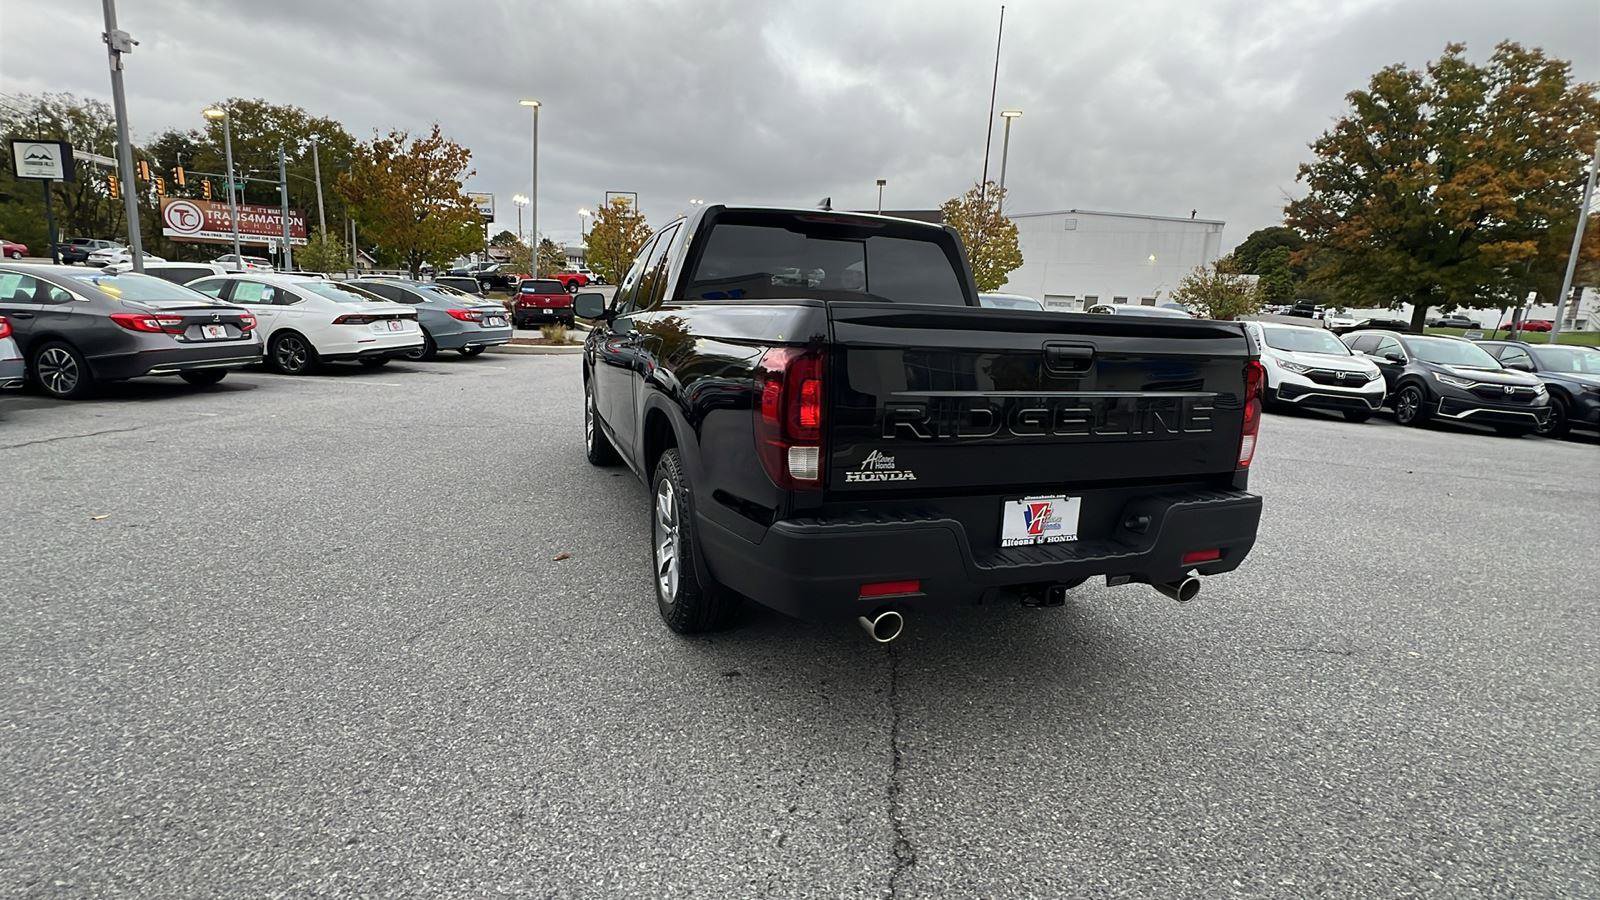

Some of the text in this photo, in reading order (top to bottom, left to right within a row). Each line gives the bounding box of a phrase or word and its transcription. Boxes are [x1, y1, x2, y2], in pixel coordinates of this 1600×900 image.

[882, 401, 1216, 438] RIDGELINE
[845, 470, 917, 482] HONDA
[1001, 534, 1079, 548] Altoona HONDA
